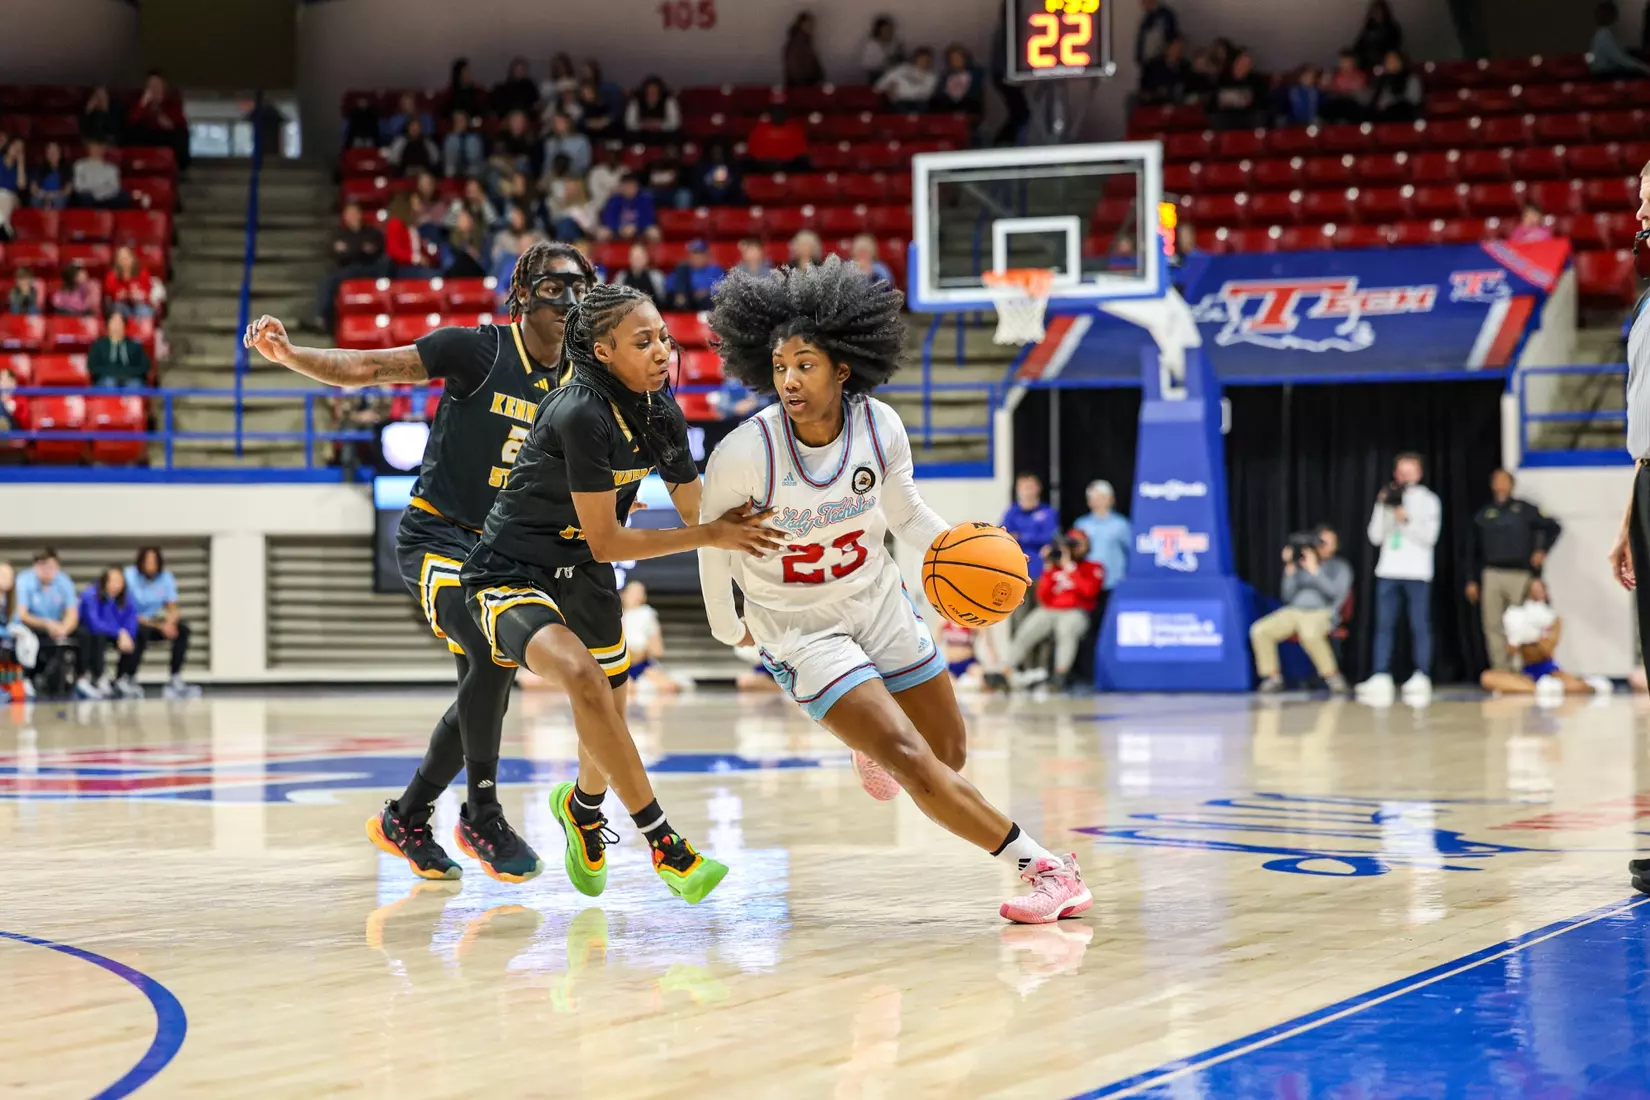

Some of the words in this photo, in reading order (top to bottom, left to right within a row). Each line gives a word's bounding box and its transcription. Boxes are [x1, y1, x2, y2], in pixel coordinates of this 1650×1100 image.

[657, 0, 718, 30] 105
[1027, 13, 1092, 67] 22
[773, 506, 814, 537] Lady
[782, 529, 868, 583] 23
